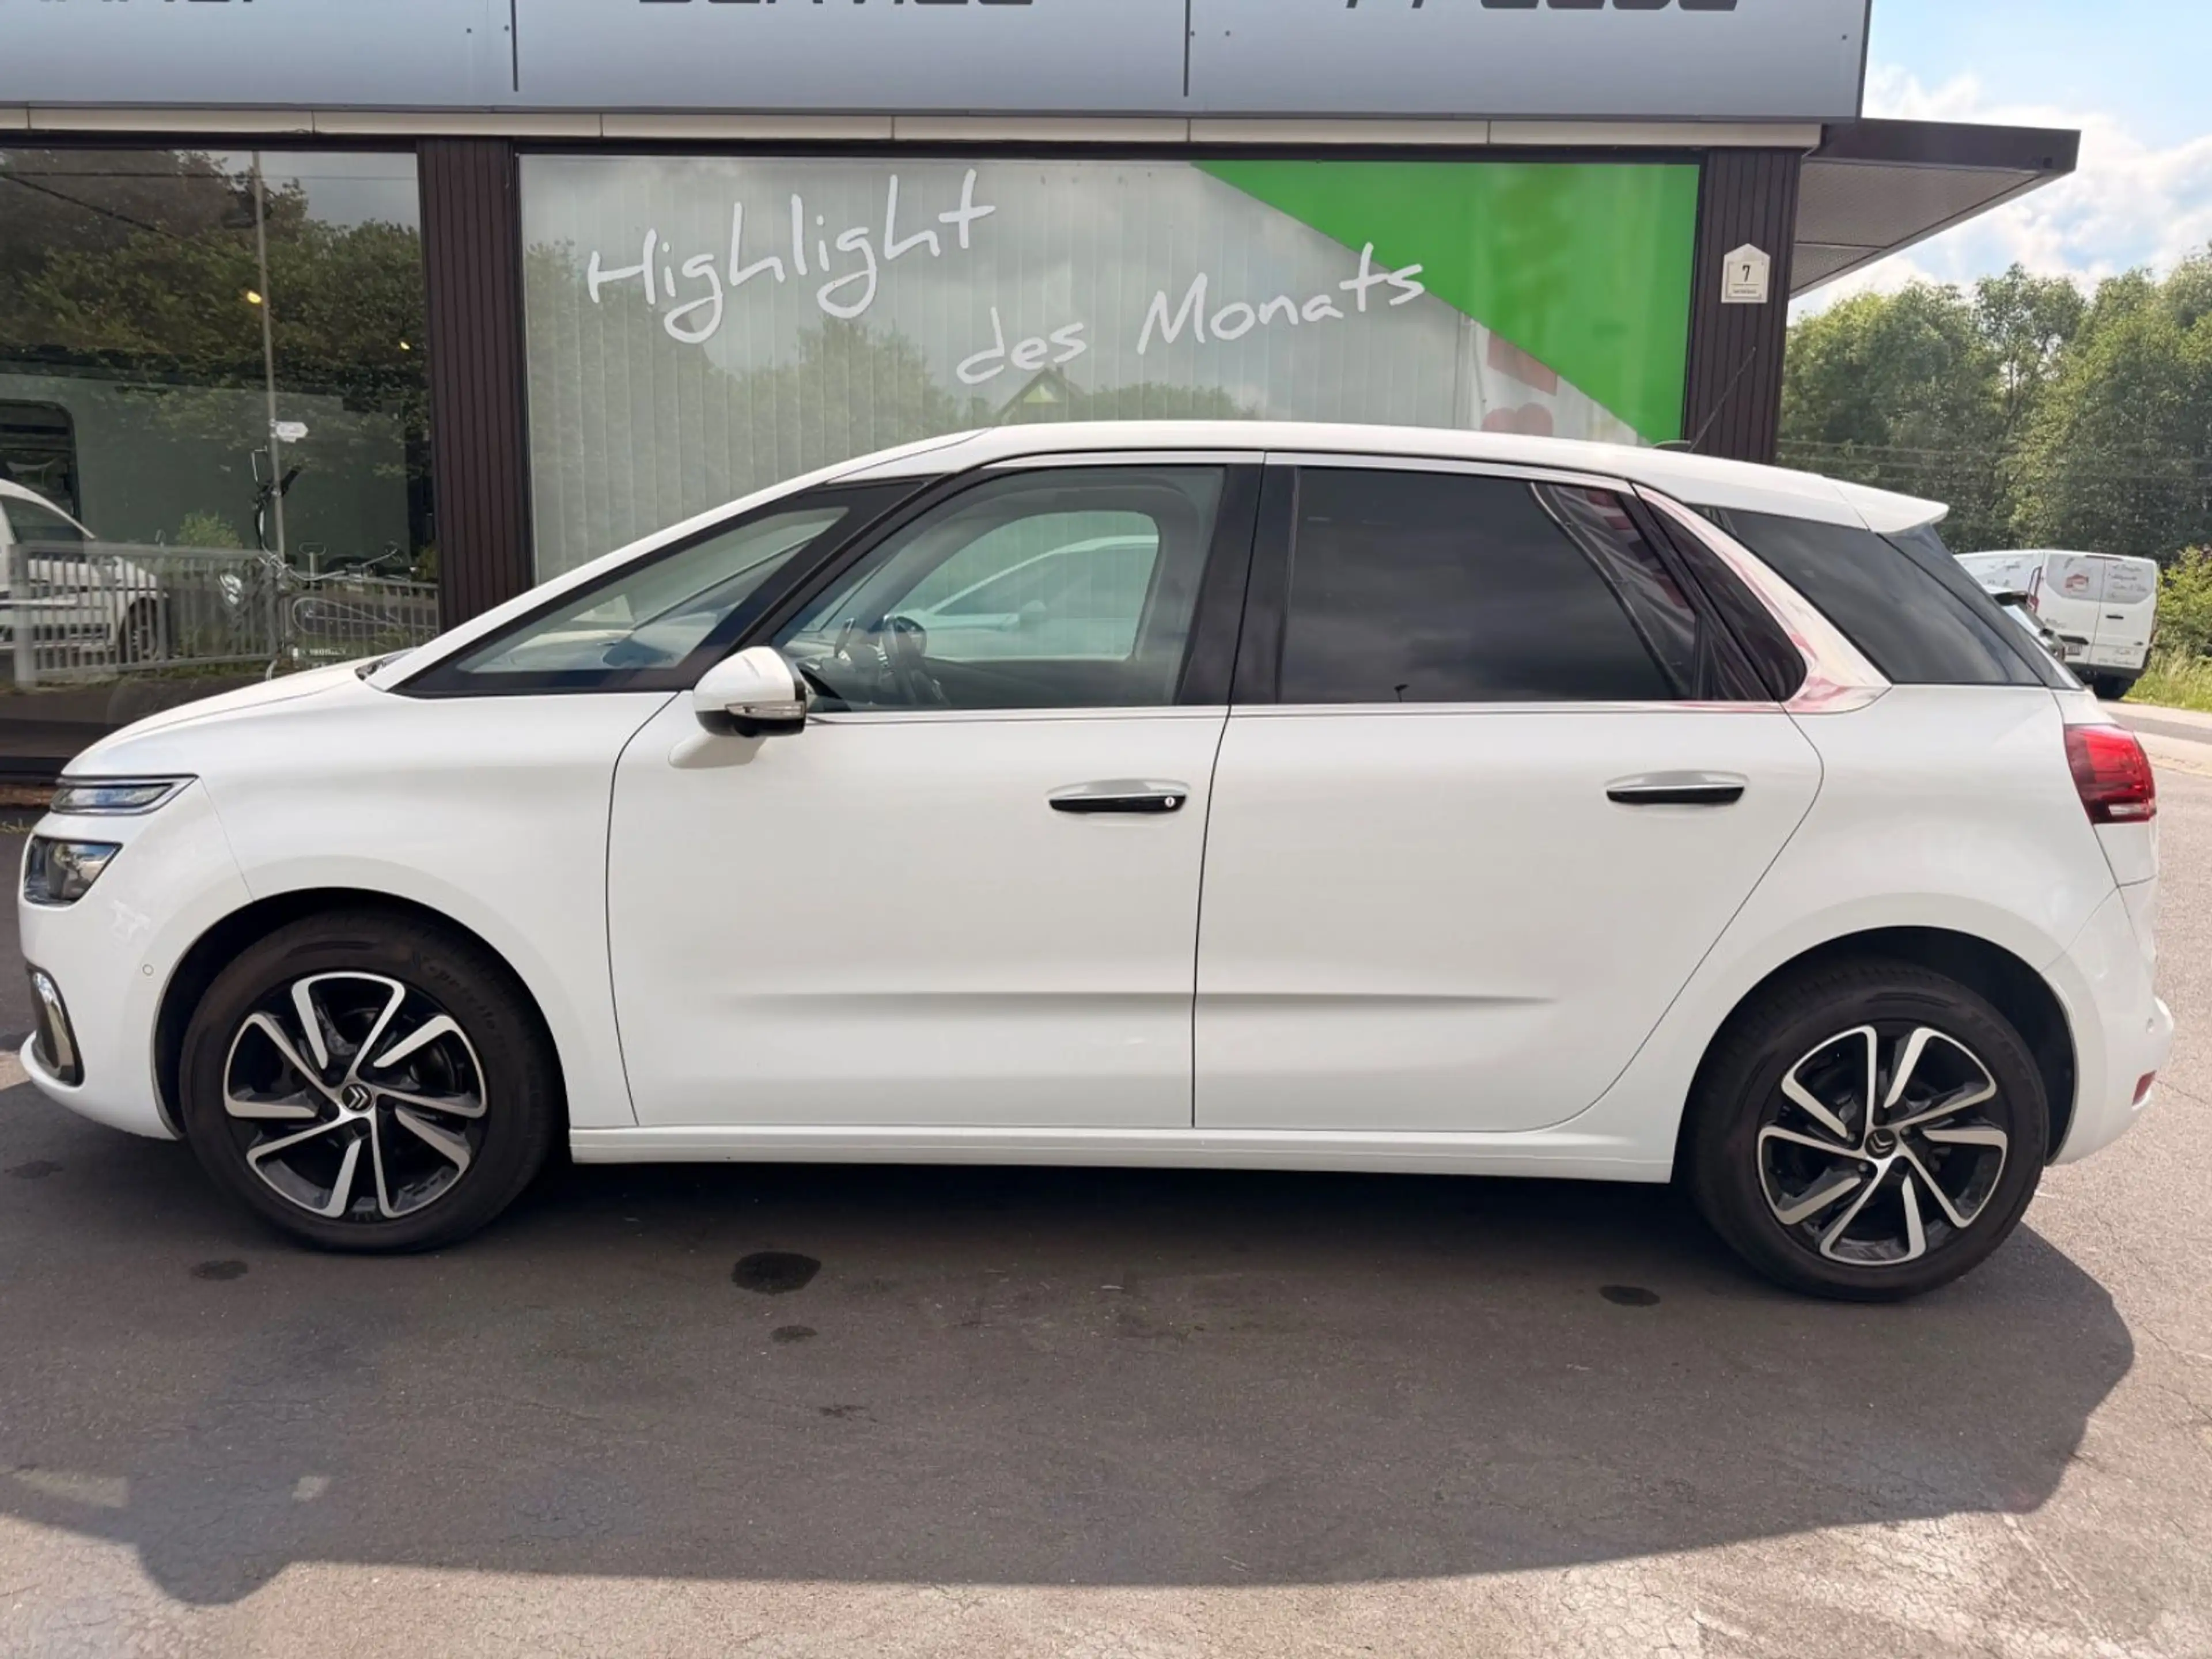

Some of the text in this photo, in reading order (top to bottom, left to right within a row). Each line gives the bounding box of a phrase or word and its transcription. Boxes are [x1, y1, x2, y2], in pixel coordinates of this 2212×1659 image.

[587, 168, 996, 343] Highlight
[956, 242, 1425, 384] des Monats
[1742, 264, 1751, 282] 7
